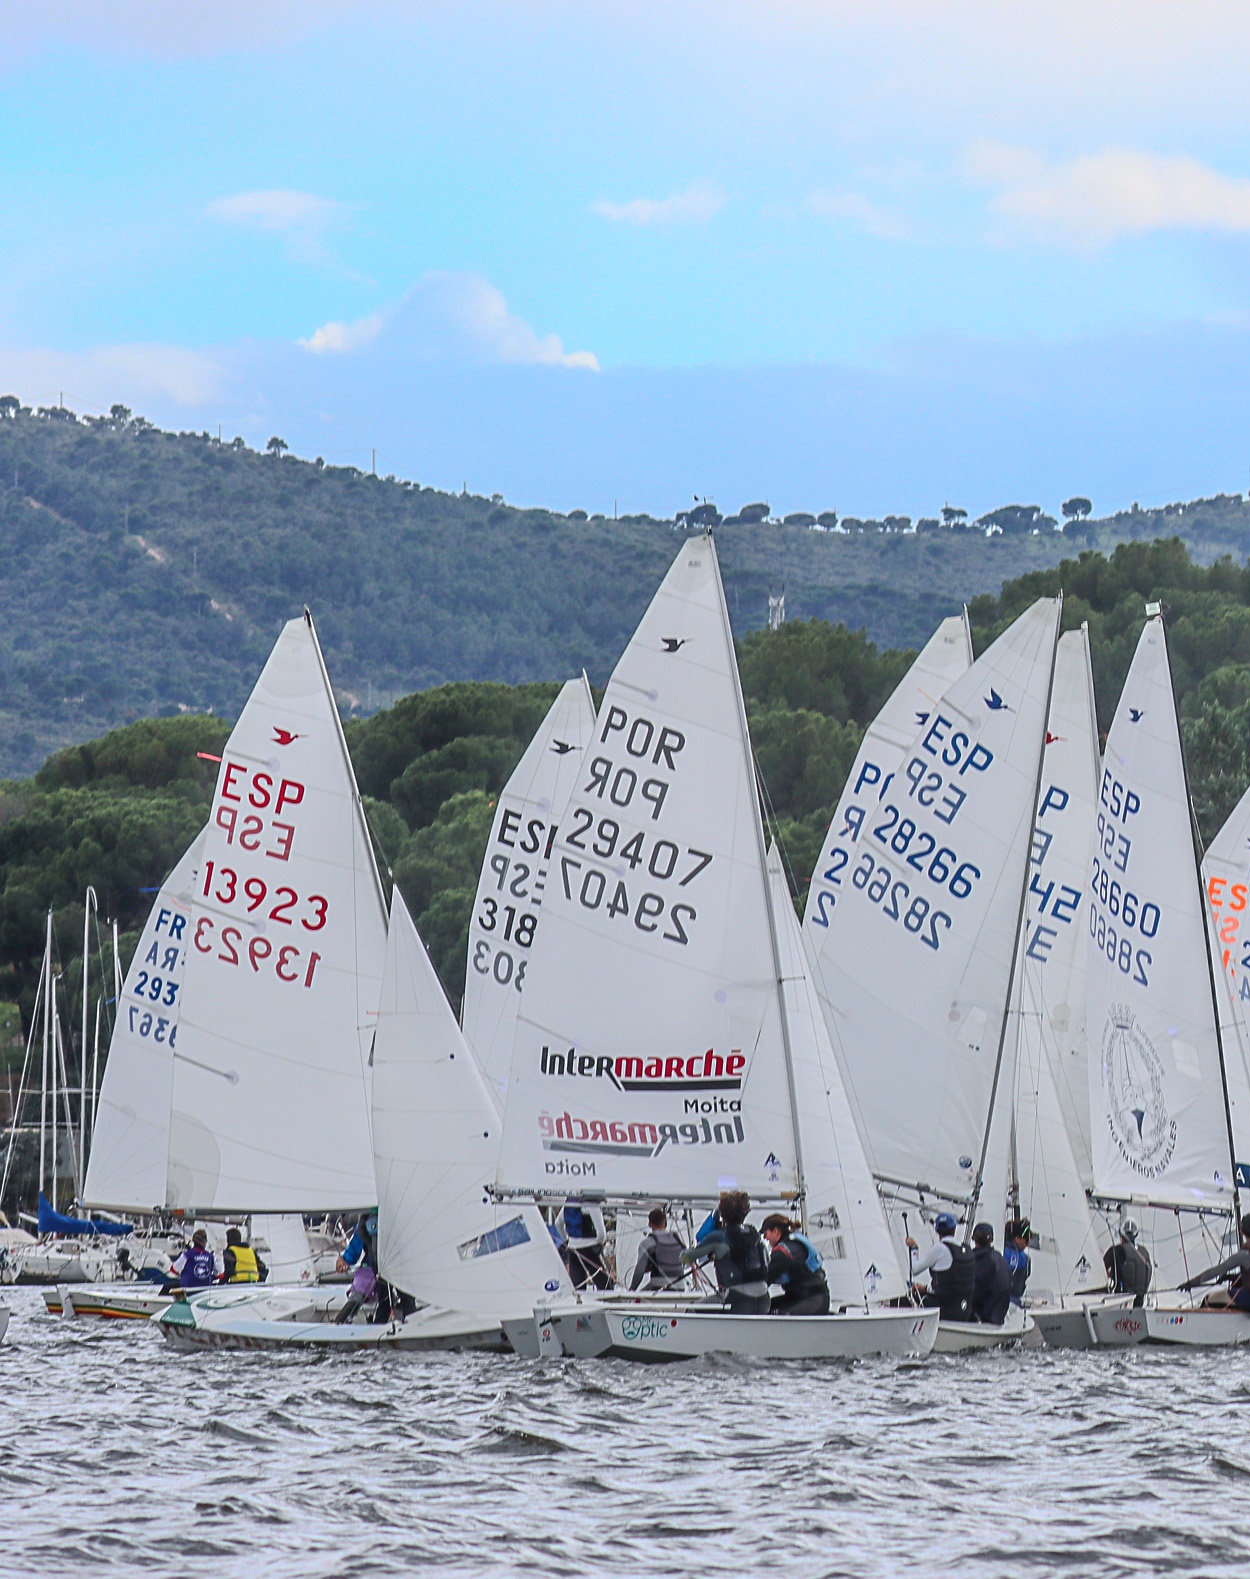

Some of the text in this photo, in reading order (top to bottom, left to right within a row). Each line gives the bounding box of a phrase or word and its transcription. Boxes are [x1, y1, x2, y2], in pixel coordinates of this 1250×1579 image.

[600, 705, 686, 771] POR
[922, 714, 994, 776] ESP
[221, 762, 305, 815] ESP
[1100, 768, 1141, 824] ESP
[566, 808, 713, 887] 29407
[873, 804, 981, 899] 28266
[202, 860, 329, 931] 13923
[1091, 857, 1161, 938] 28660
[1207, 876, 1249, 912] ES
[154, 908, 187, 941] FR
[478, 897, 538, 948] 318
[133, 970, 180, 1007] 293
[684, 1099, 742, 1114] Moita
